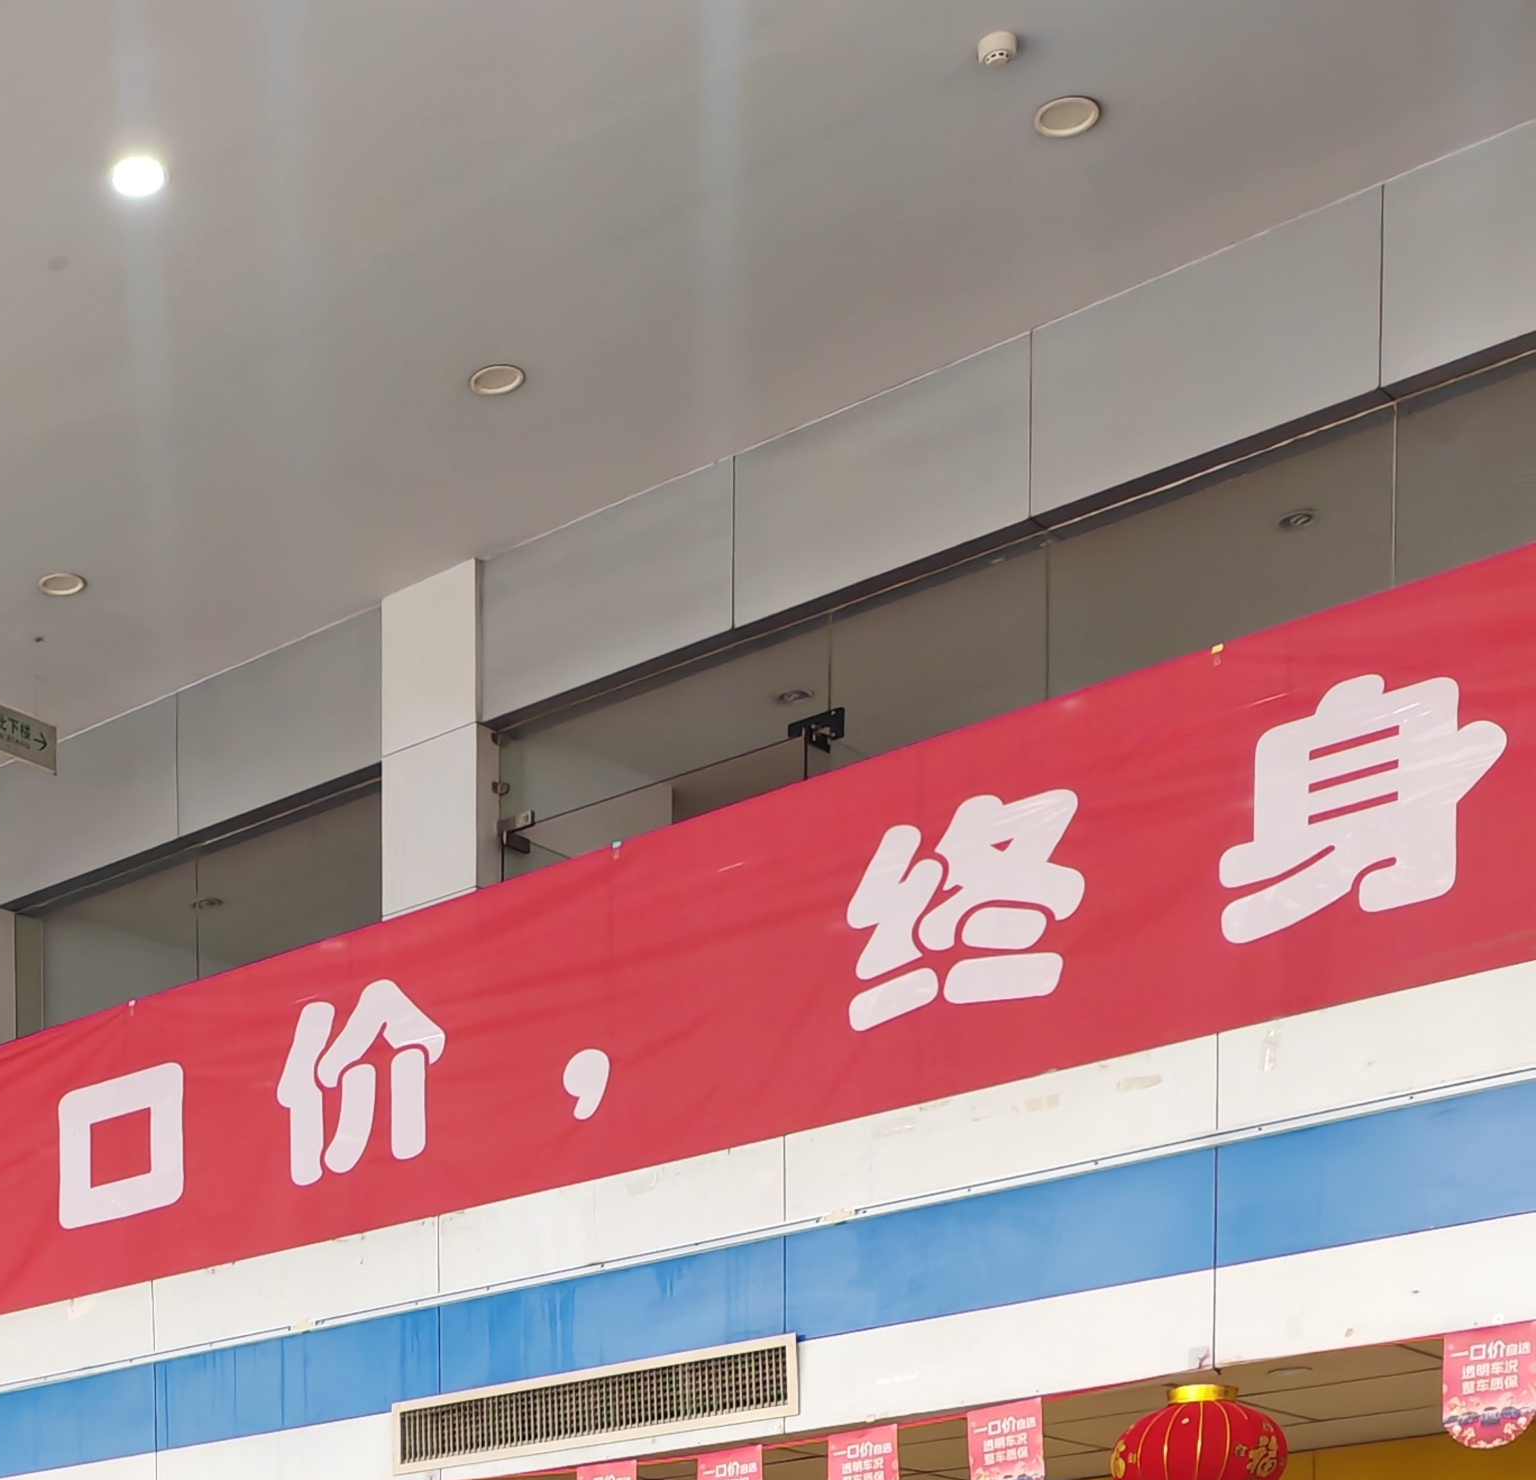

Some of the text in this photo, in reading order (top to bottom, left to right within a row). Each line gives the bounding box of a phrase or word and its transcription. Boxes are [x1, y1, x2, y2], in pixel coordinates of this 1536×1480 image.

[1450, 1340, 1532, 1361] 一口价自选
[1461, 1359, 1519, 1380] 透明车况
[1461, 1374, 1519, 1396] 整车质保
[1247, 1436, 1278, 1477] 福
